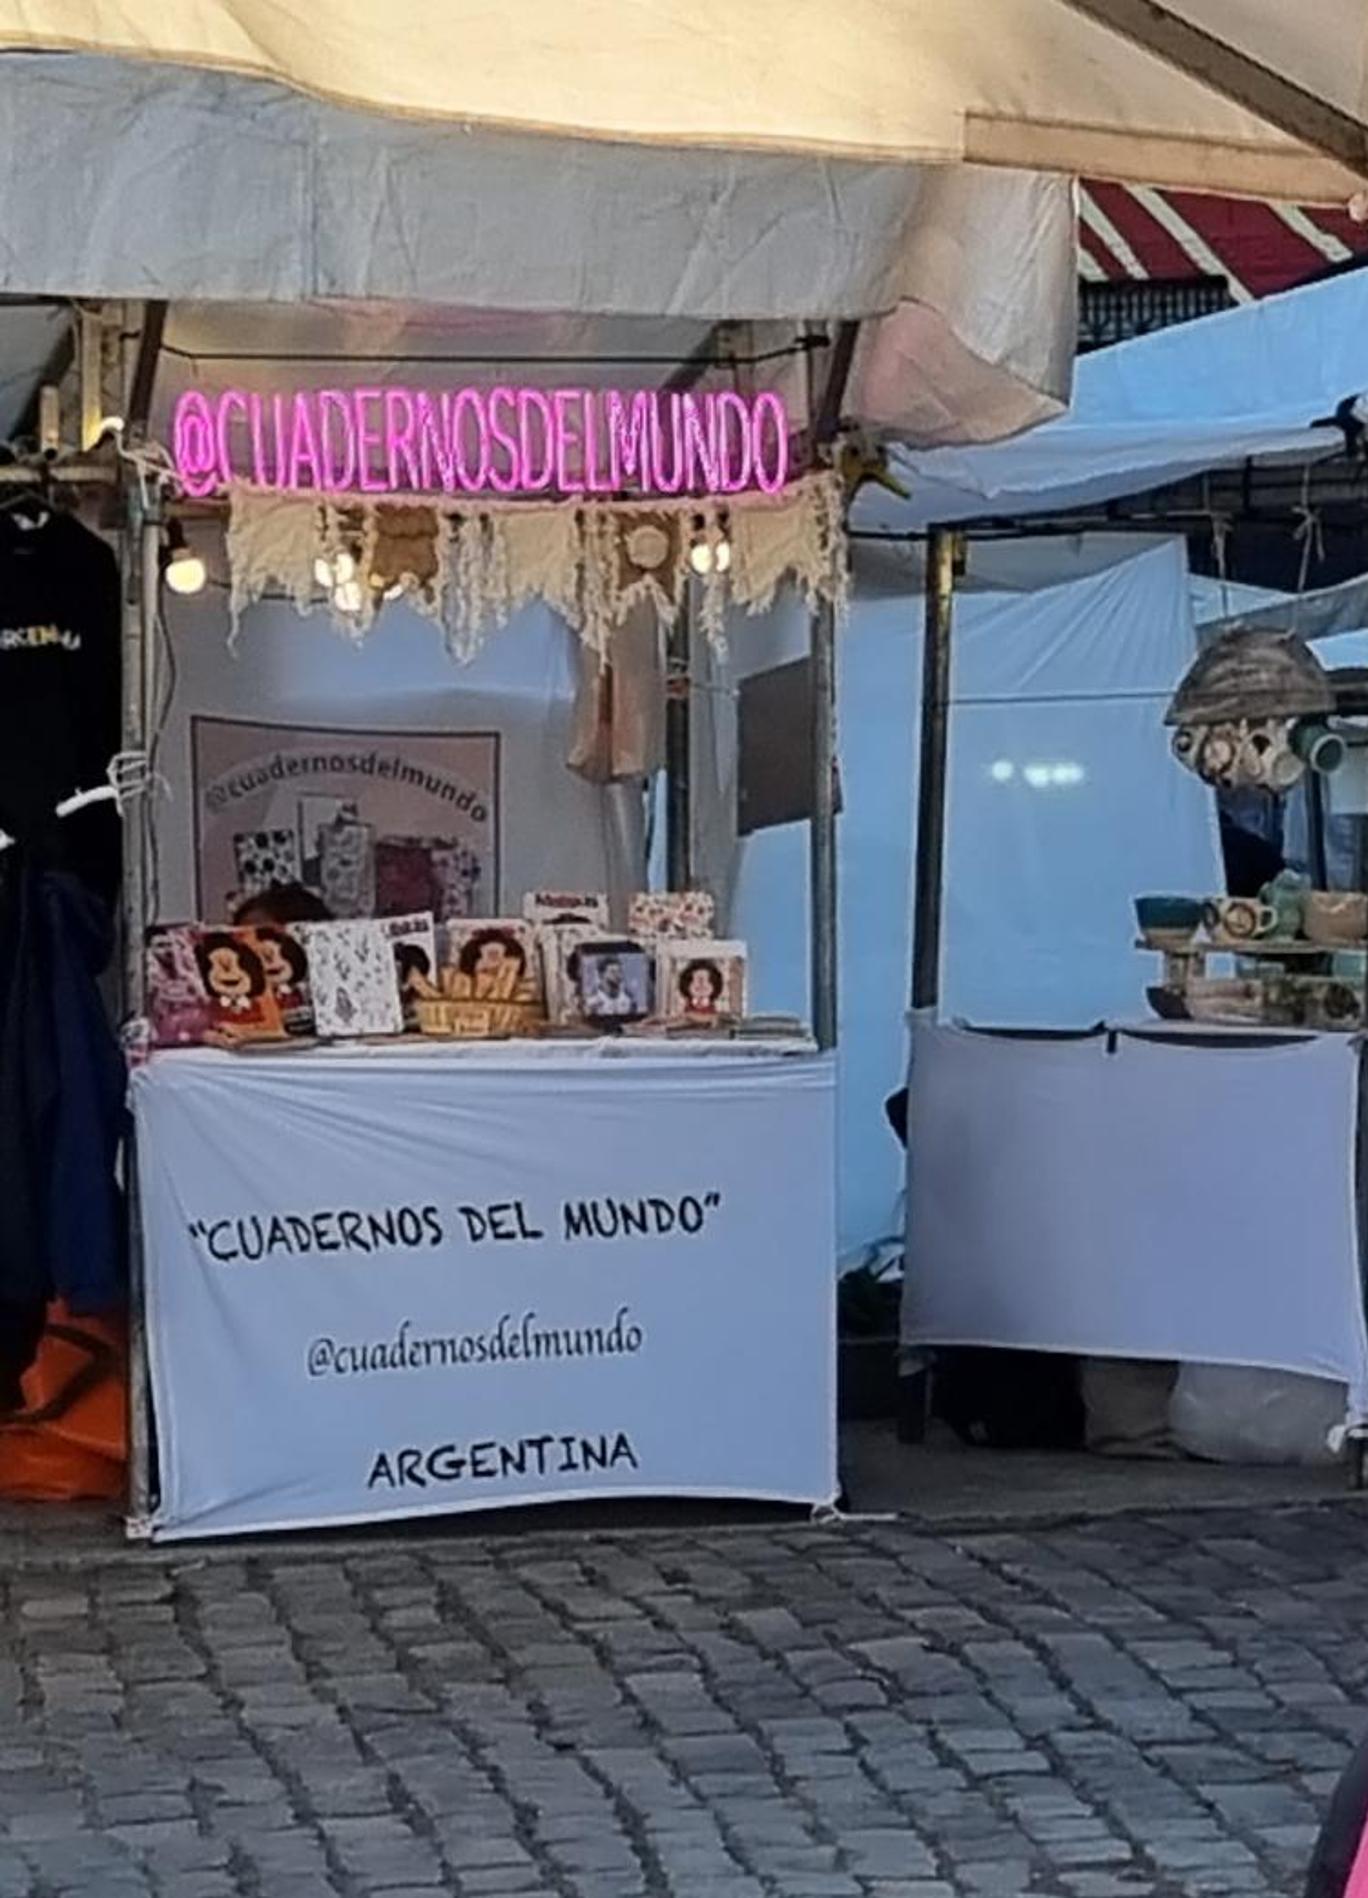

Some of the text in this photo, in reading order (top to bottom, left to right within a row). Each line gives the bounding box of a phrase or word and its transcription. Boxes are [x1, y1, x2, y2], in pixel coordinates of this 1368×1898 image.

[174, 387, 789, 497] @CUADERNOSDELMUNDO
[457, 1201, 545, 1243] DEL
[307, 1306, 643, 1377] @cuadernosdelmundo
[367, 1432, 639, 1489] ARGENTINA
